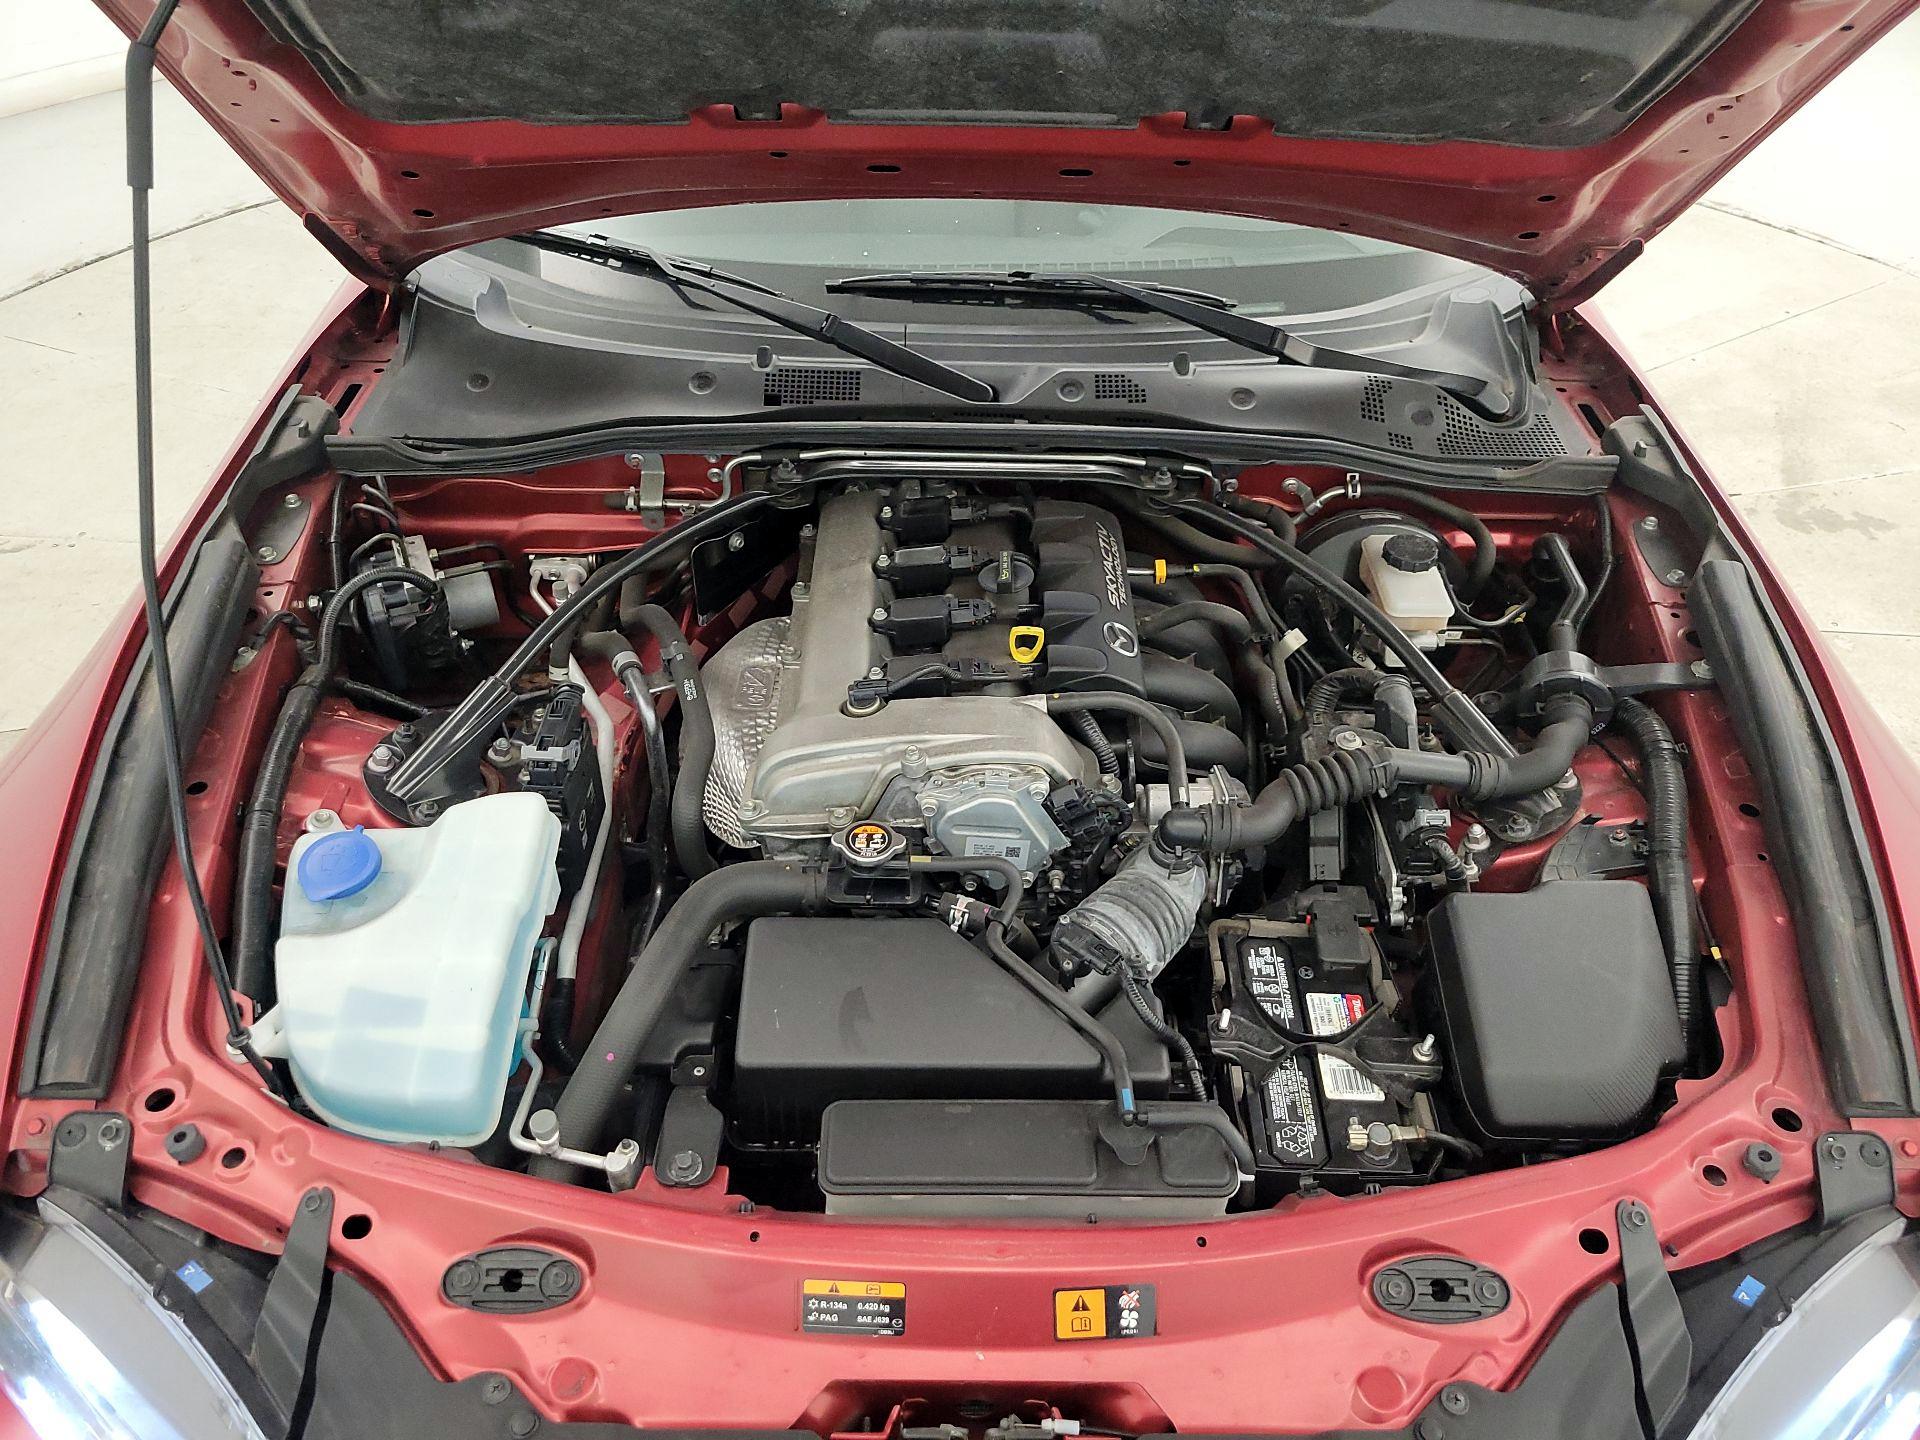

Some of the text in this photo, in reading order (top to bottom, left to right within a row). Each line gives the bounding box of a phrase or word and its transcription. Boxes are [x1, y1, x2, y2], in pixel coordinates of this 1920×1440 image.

[1096, 521, 1120, 611] SKYACTIV
[1109, 532, 1127, 606] TECHNOLOGY
[820, 1300, 890, 1312] R-134a 0.420 kg
[820, 1313, 838, 1321] PAG
[857, 1315, 872, 1323] SAE
